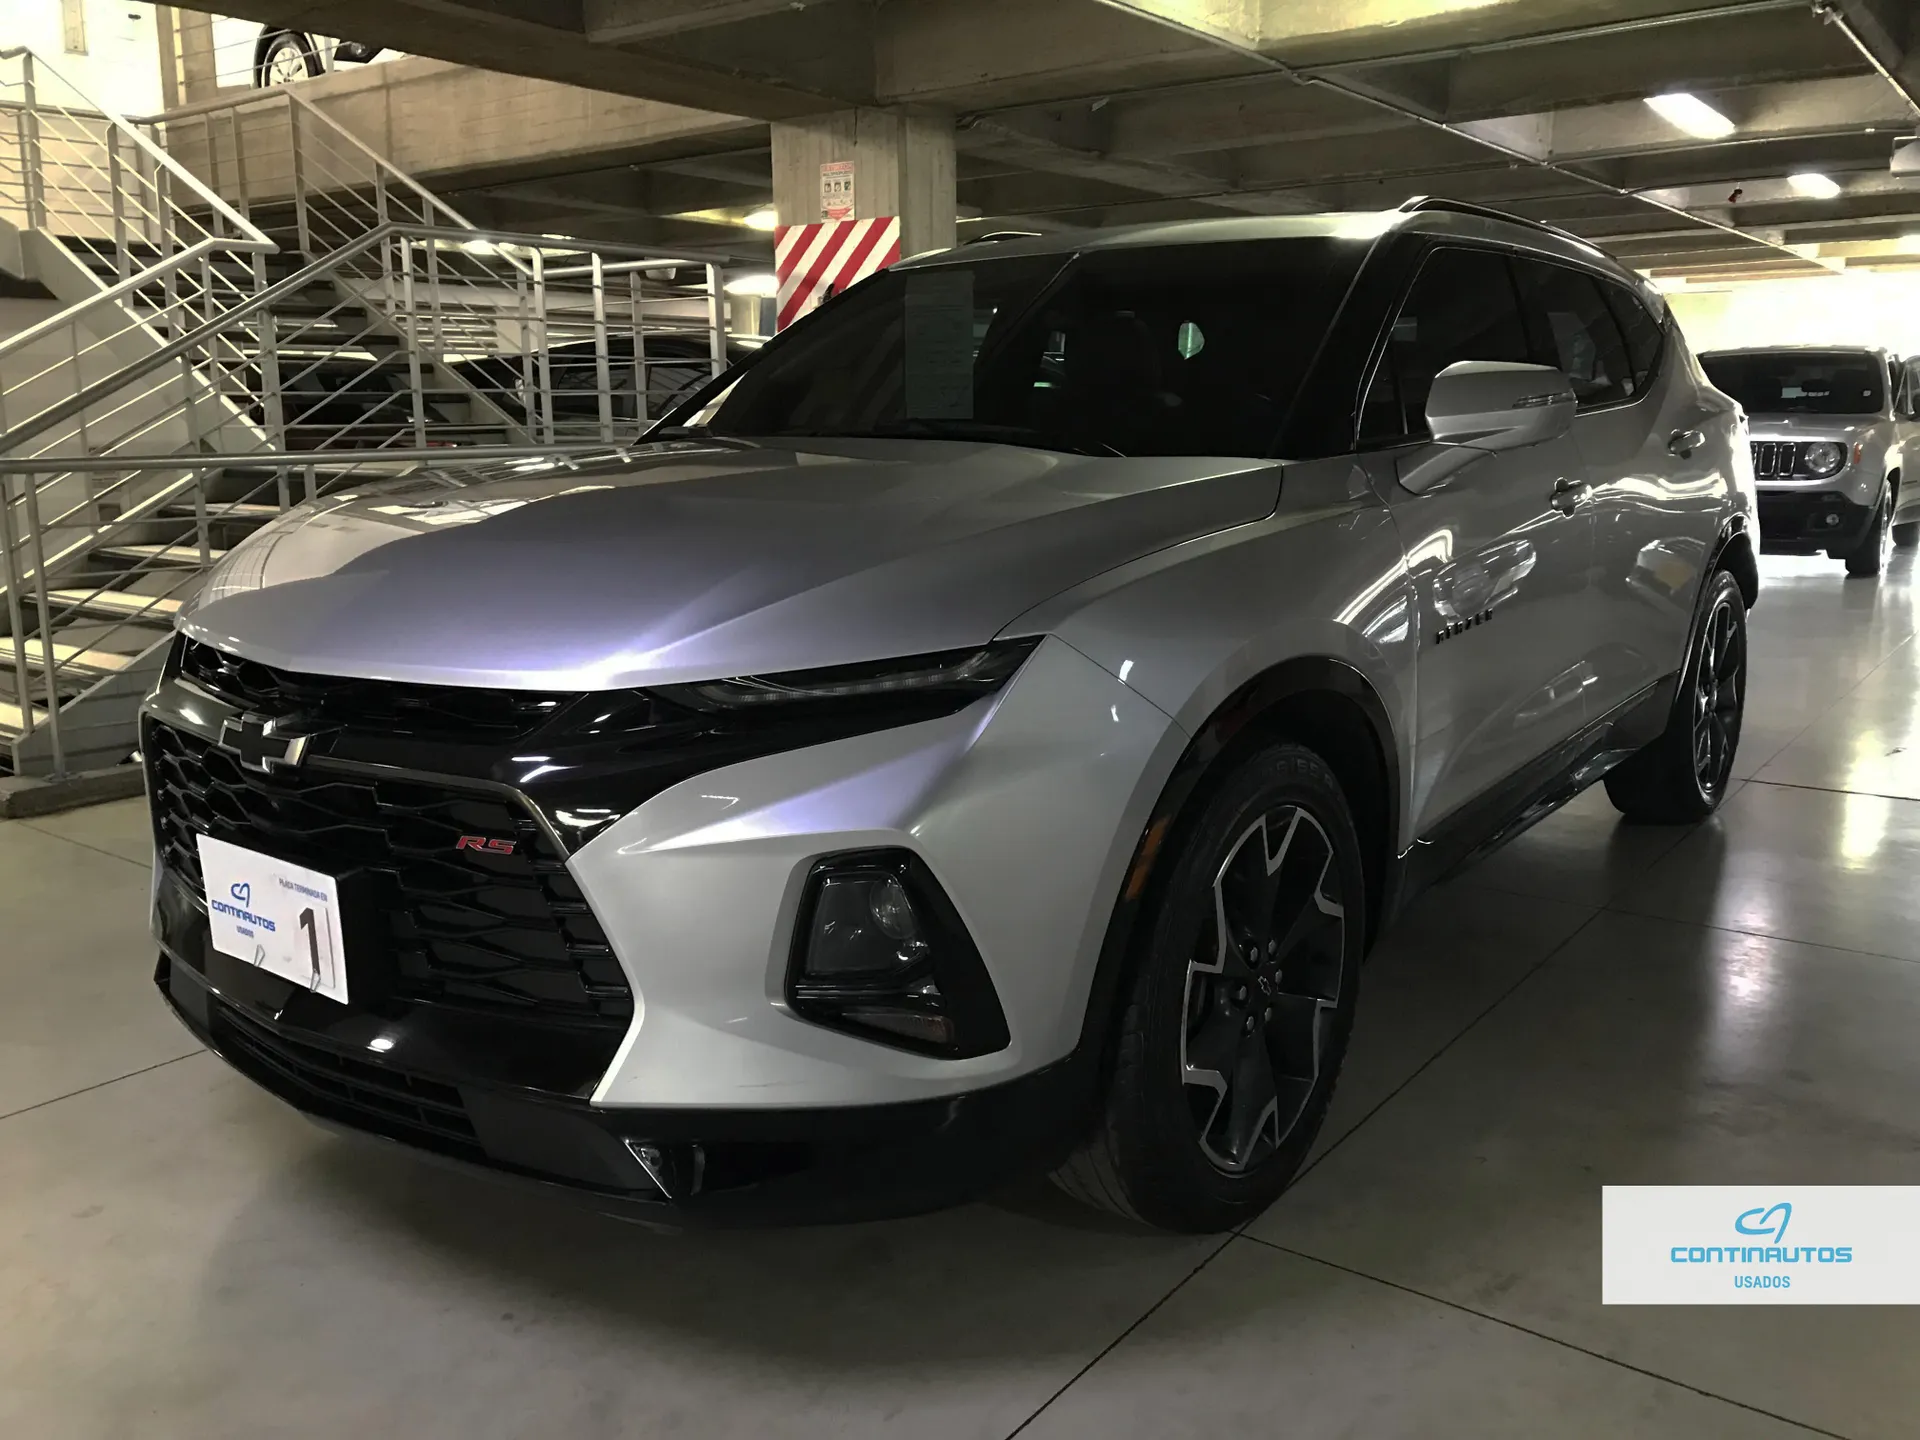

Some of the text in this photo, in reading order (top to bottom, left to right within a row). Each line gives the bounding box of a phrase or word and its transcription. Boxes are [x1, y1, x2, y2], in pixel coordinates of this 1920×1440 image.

[456, 835, 516, 855] RS
[278, 878, 294, 890] PLACA
[211, 899, 276, 932] CONTINAUTOS
[299, 907, 321, 975] 1
